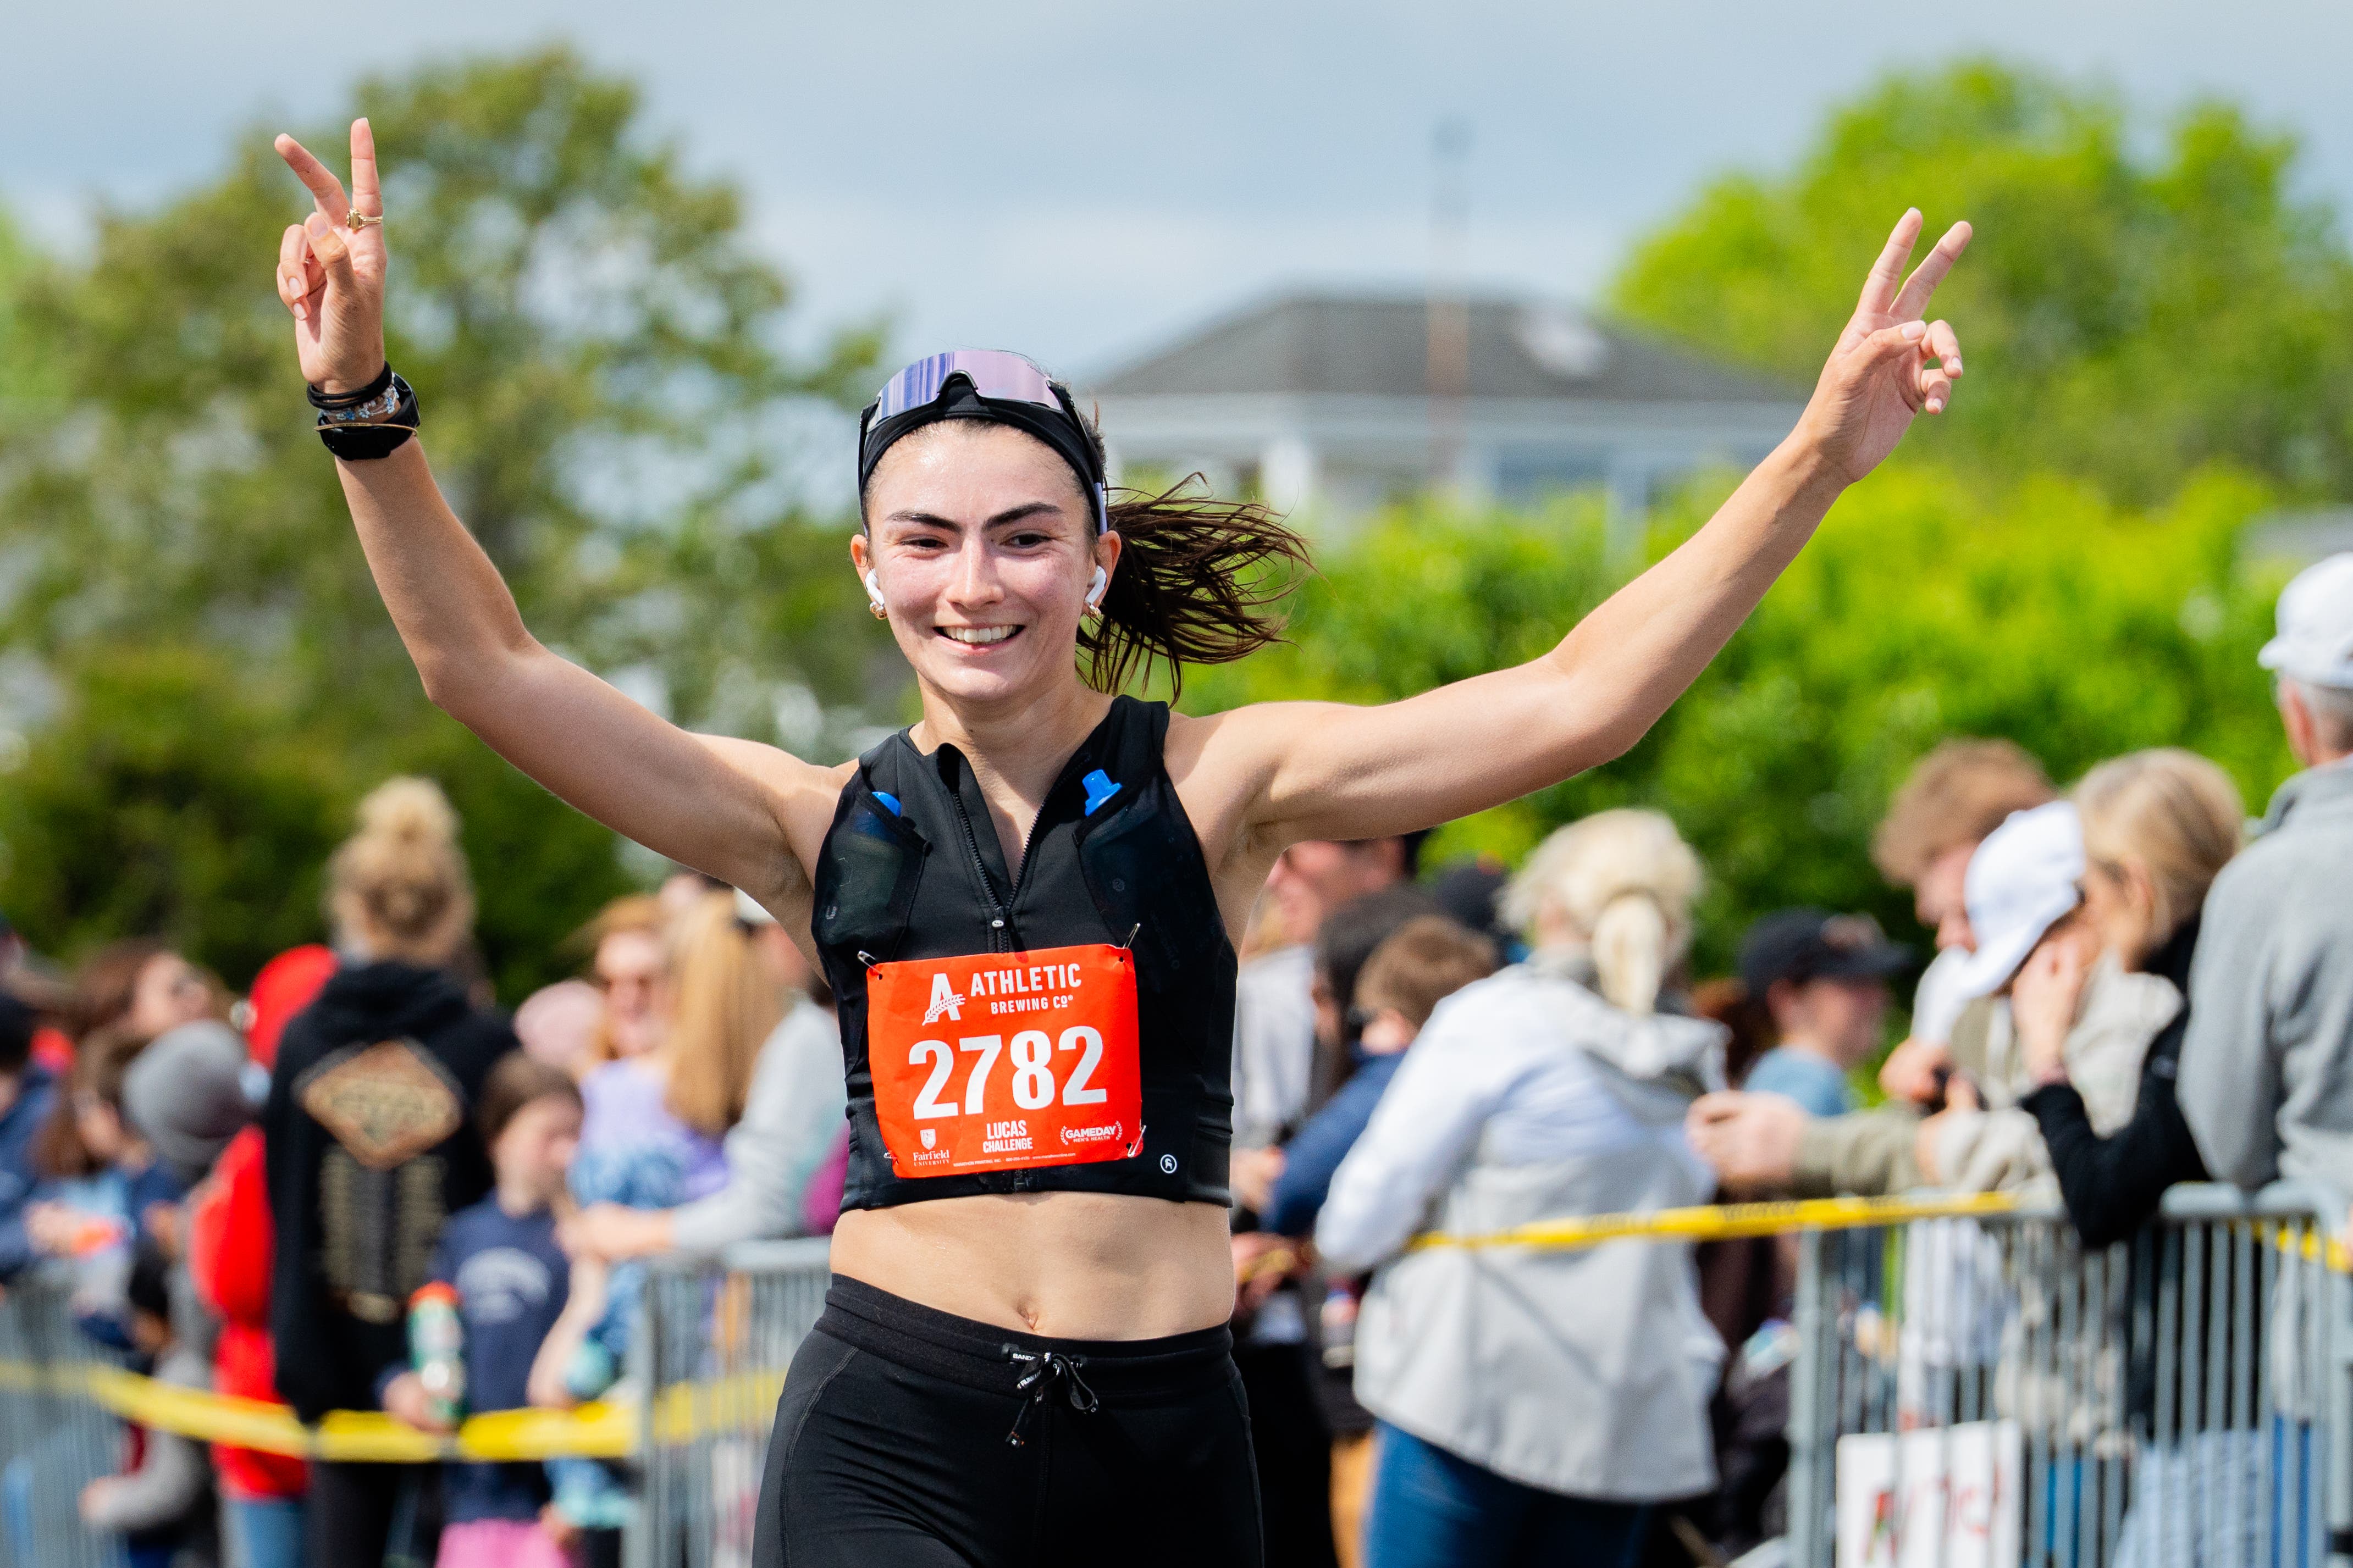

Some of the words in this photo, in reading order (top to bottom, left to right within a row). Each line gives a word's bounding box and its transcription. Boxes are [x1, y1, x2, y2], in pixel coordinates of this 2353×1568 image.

[970, 963, 1082, 997] ATHLETIC
[990, 996, 1048, 1015] BREWING
[908, 1025, 1107, 1120] 2782
[986, 1120, 1027, 1140] LUCAS
[1065, 1126, 1117, 1139] GAMEDAY
[913, 1149, 950, 1161] Fairfield
[982, 1137, 1033, 1154] CHALLENGE
